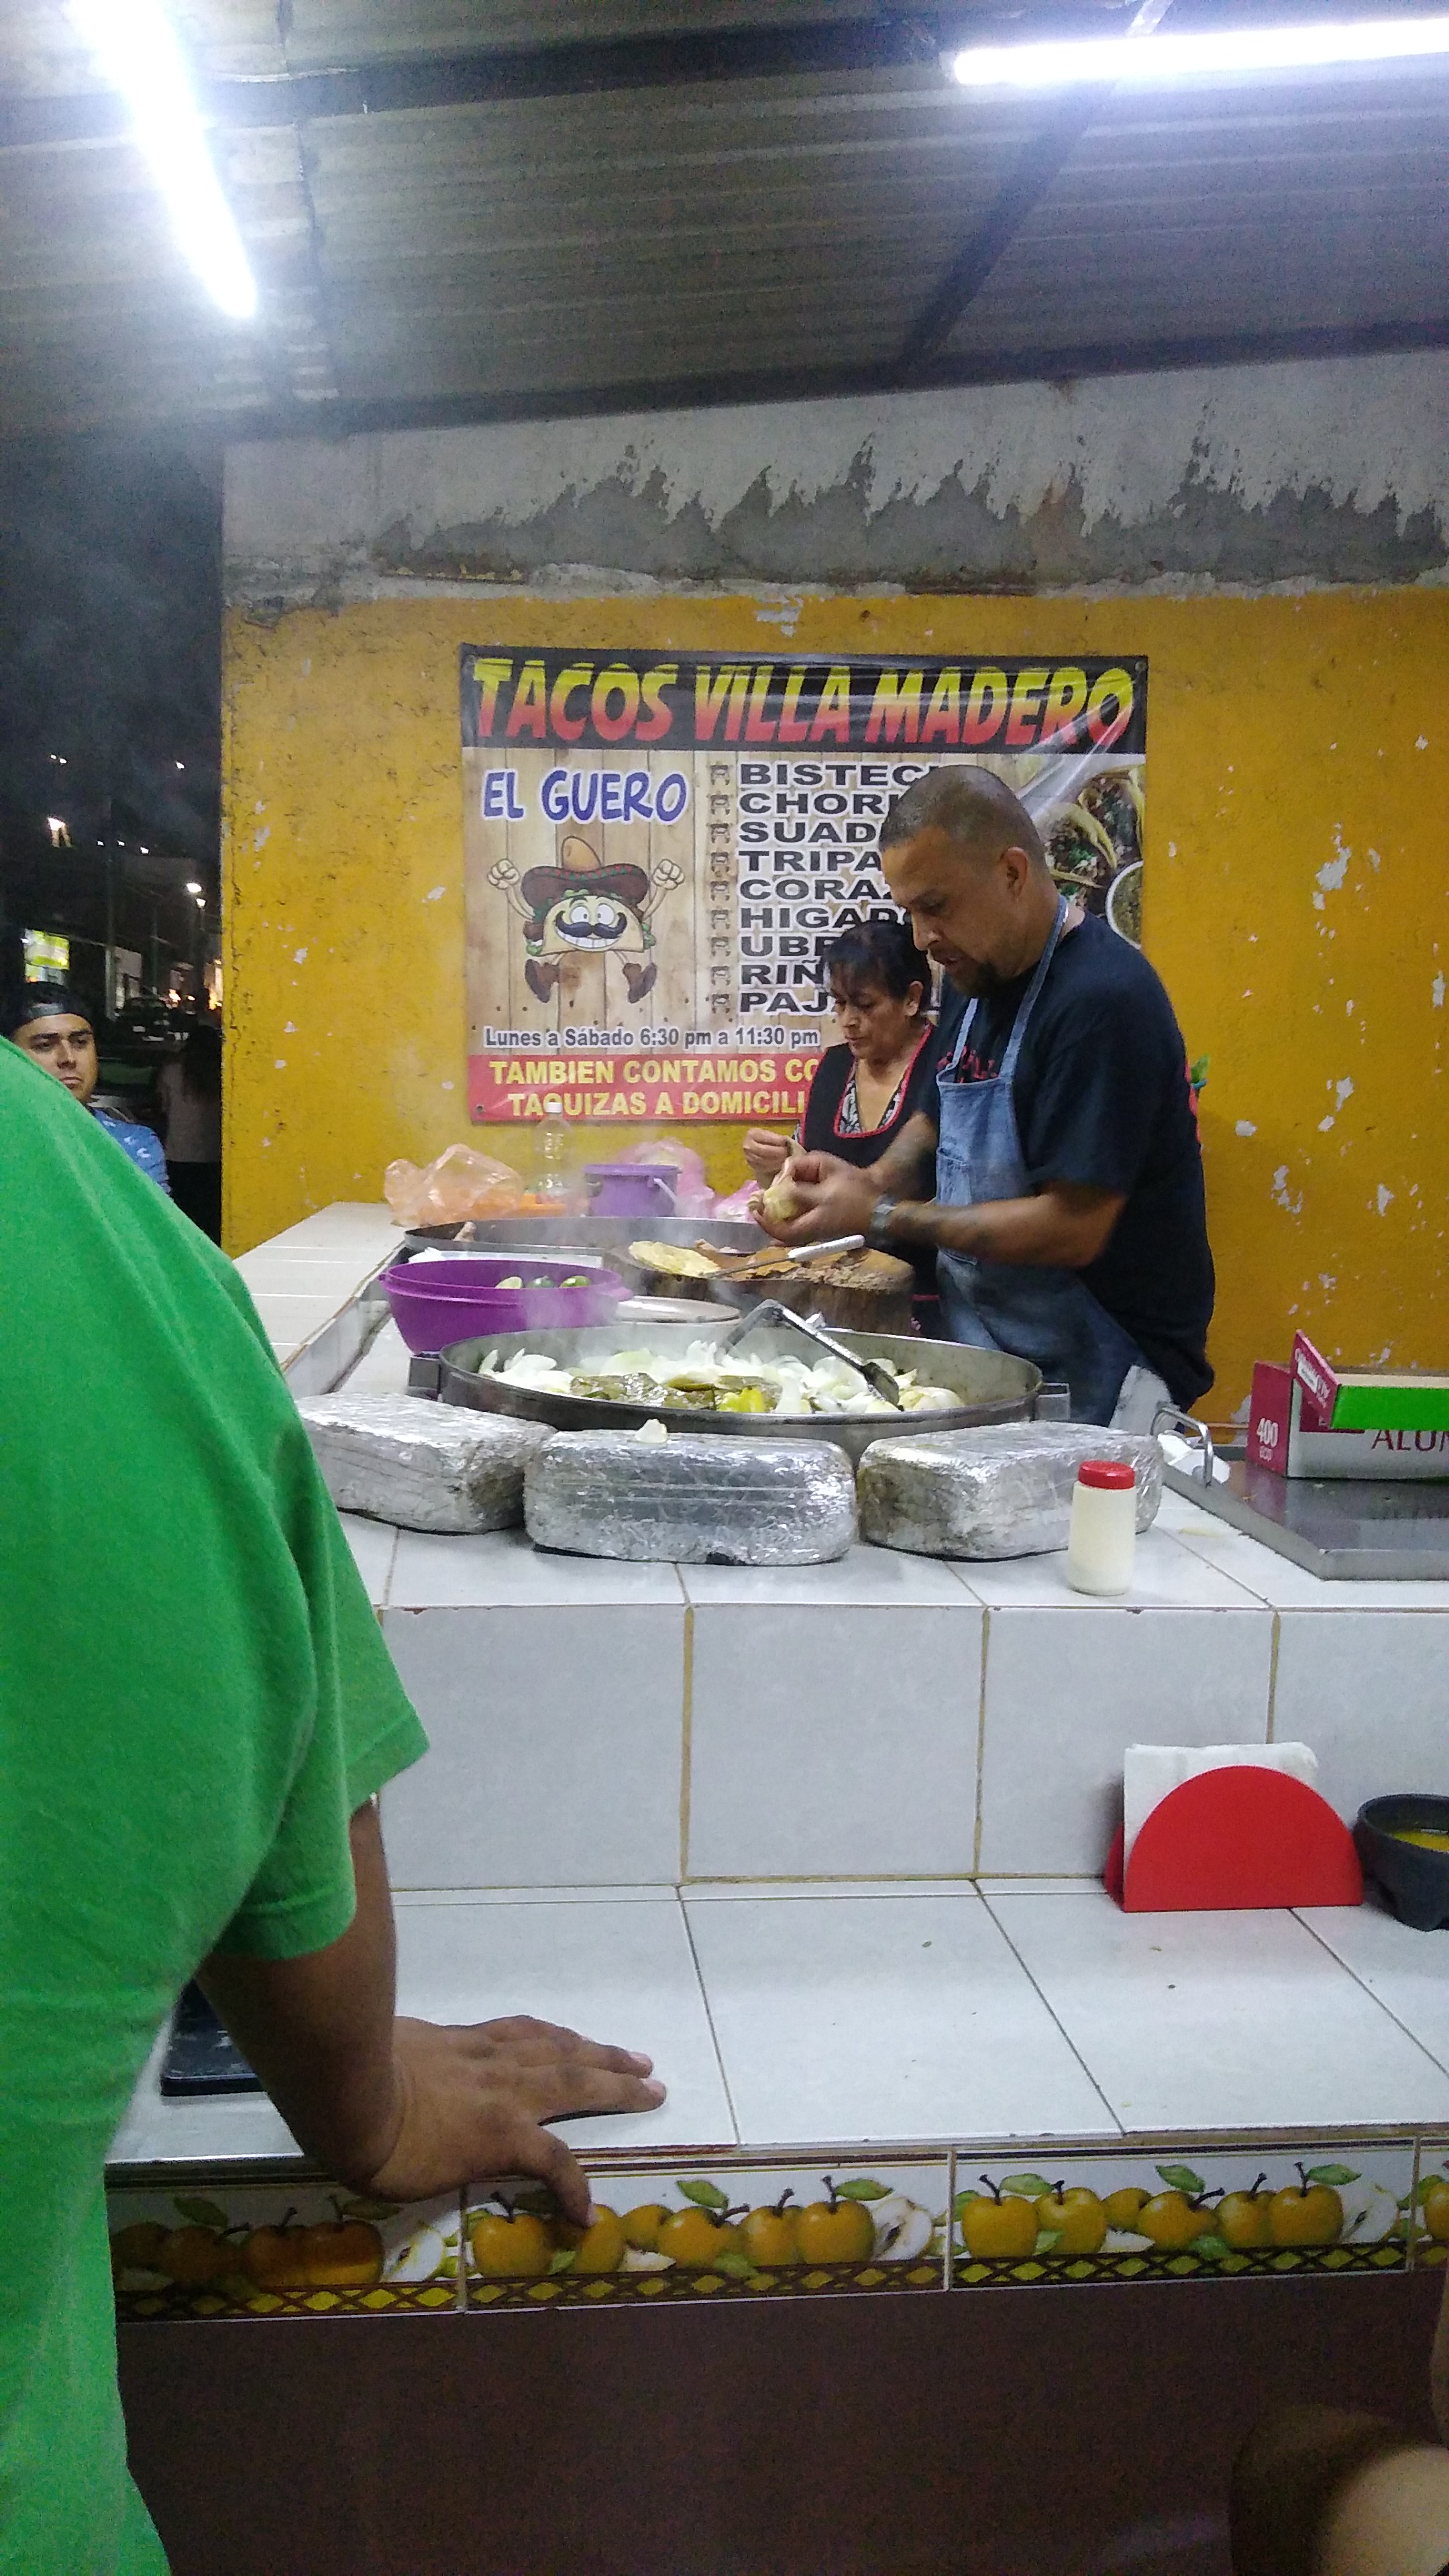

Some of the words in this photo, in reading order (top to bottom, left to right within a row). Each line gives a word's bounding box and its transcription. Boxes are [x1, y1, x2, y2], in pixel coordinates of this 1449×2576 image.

[474, 658, 677, 741] TACOS
[694, 665, 850, 742] VILLA
[864, 666, 1135, 746] MADERO
[741, 764, 938, 786] BISTEC
[484, 772, 524, 818] EL
[541, 770, 687, 822] GUERO
[740, 794, 899, 814] CHORI
[740, 822, 876, 843] SUAD
[740, 879, 892, 900] CORA
[742, 959, 824, 984] RIÑ
[741, 993, 835, 1012] PAJ
[485, 1028, 541, 1046] Lunes
[548, 1033, 557, 1046] a
[566, 1029, 633, 1046] Sábado
[641, 1029, 679, 1045] 6:30
[685, 1032, 711, 1049] pm
[718, 1032, 728, 1044] a
[737, 1028, 784, 1044] 11:30
[792, 1032, 817, 1049] pm
[490, 1061, 614, 1084] TAMBIEN
[624, 1060, 775, 1083] CONTAMOS
[785, 1059, 818, 1082] CO
[508, 1093, 645, 1116] TAQUIZAS
[655, 1092, 674, 1114] A
[684, 1091, 805, 1114] DOMICILI
